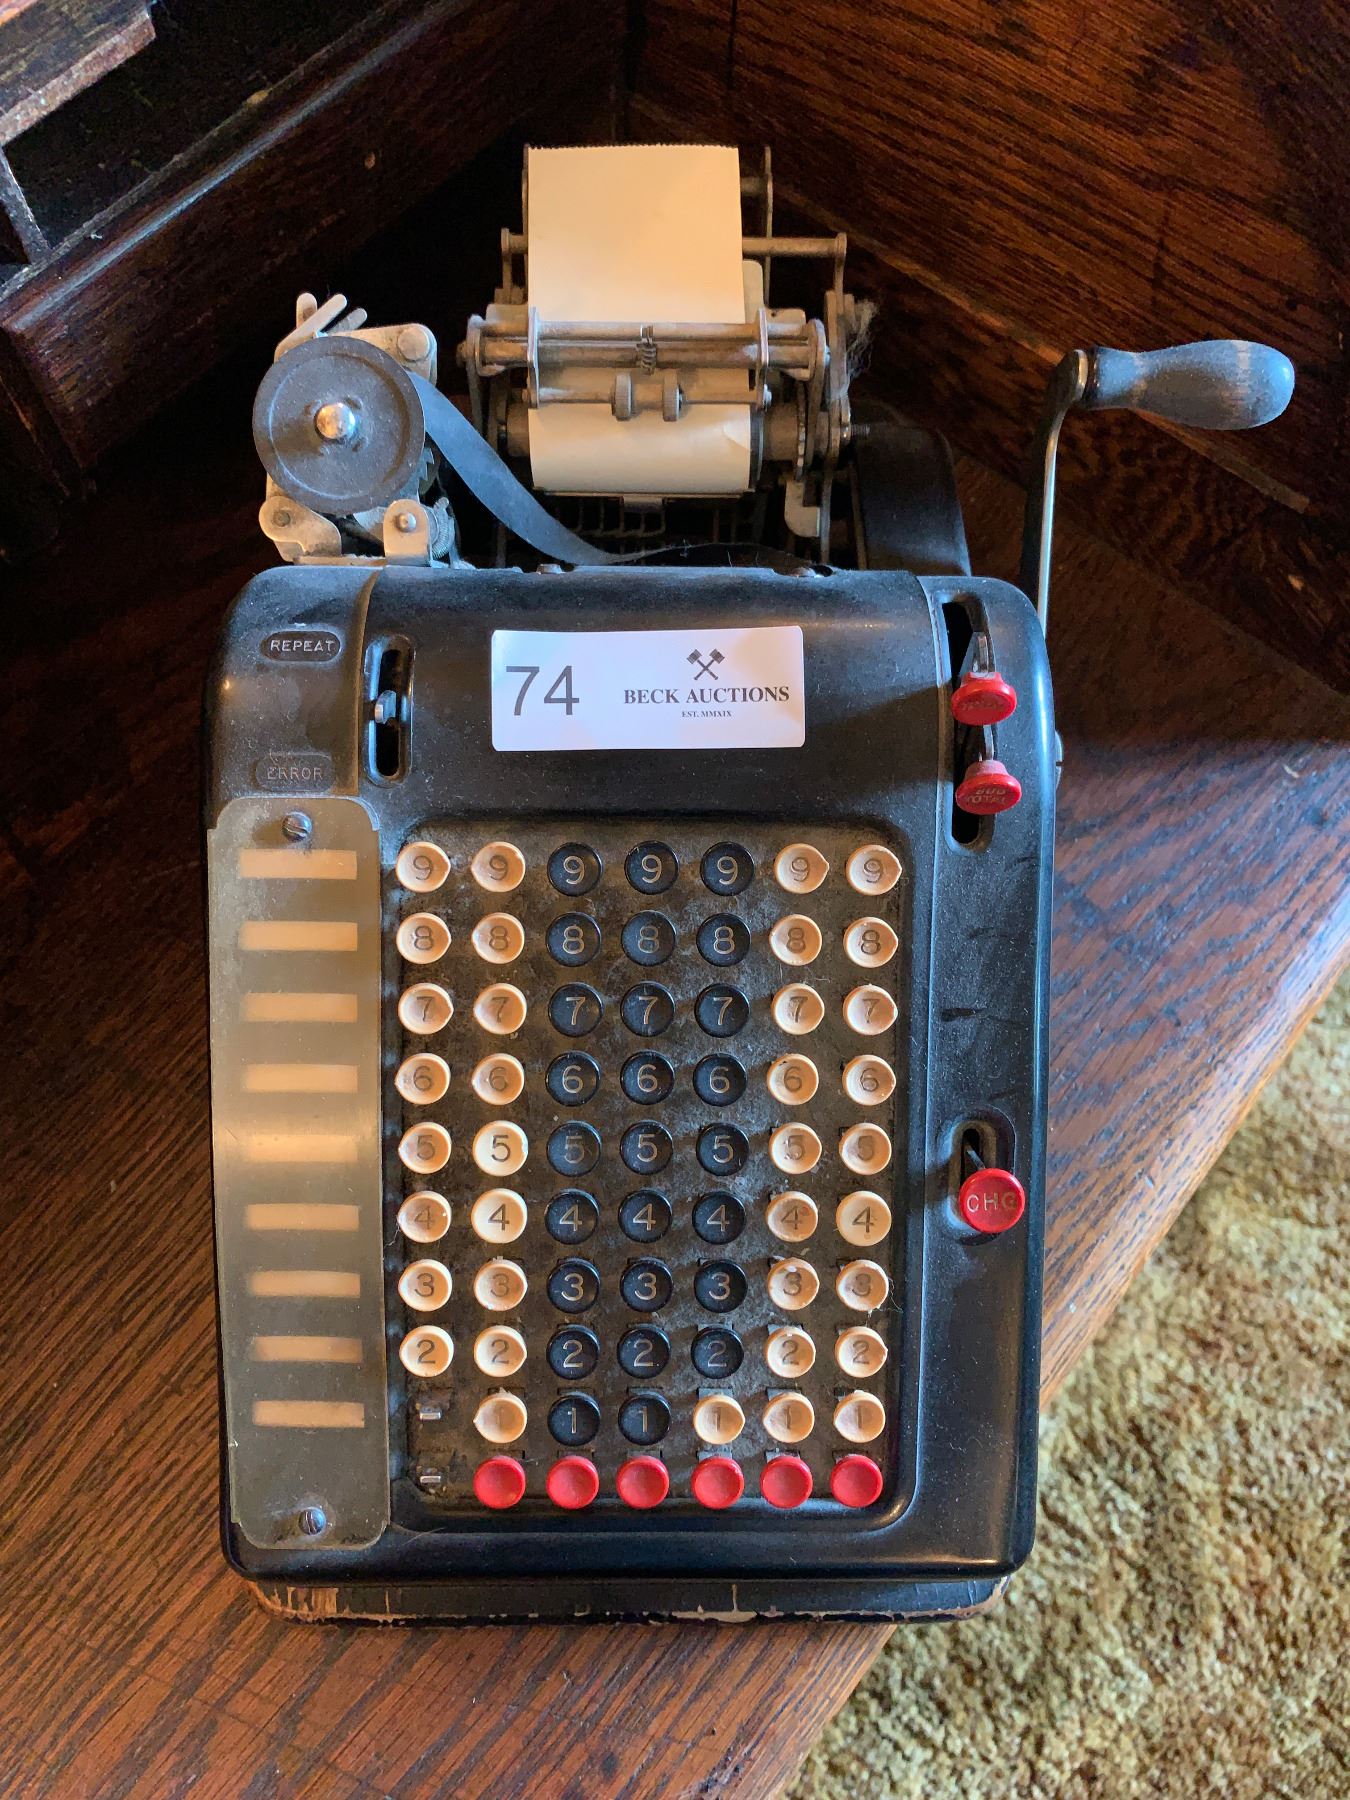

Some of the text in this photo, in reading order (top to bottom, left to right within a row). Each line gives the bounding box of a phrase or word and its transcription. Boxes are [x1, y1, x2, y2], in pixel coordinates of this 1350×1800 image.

[269, 639, 336, 653] REPEAT
[505, 664, 580, 716] 74
[623, 685, 791, 705] BECK AUCTIONS
[681, 710, 733, 719] EST. MMXIX
[267, 766, 324, 781] ERROR
[413, 855, 433, 881] 9
[489, 854, 509, 881] 9
[565, 855, 585, 885] 9
[642, 855, 663, 884] 9
[718, 855, 738, 885] 9
[791, 856, 810, 882] 9
[863, 858, 883, 884] 9
[413, 925, 434, 951] 8
[488, 925, 509, 951] 8
[563, 925, 585, 954] 8
[638, 924, 660, 953] 8
[714, 926, 736, 955] 8
[786, 927, 806, 954] 8
[860, 929, 882, 955] 8
[416, 995, 435, 1023] 7
[491, 996, 510, 1023] 7
[565, 996, 587, 1026] 7
[638, 995, 659, 1025] 7
[712, 996, 733, 1026] 7
[789, 995, 808, 1023] 7
[861, 998, 881, 1024] 7
[413, 1065, 433, 1092] 6
[488, 1066, 509, 1092] 6
[561, 1065, 585, 1095] 6
[636, 1063, 658, 1093] 6
[709, 1065, 731, 1095] 6
[783, 1066, 803, 1093] 6
[859, 1067, 880, 1093] 6
[416, 1134, 435, 1161] 5
[491, 1134, 511, 1163] 5
[564, 1135, 585, 1164] 5
[636, 1132, 658, 1162] 5
[712, 1133, 734, 1163] 5
[785, 1134, 805, 1161] 5
[857, 1135, 875, 1162] 5
[966, 1191, 1017, 1213] CHG
[414, 1205, 435, 1230] 4
[487, 1203, 511, 1231] 4
[558, 1202, 583, 1232] 4
[632, 1202, 657, 1232] 4
[706, 1203, 731, 1233] 4
[781, 1205, 803, 1231] 4
[851, 1206, 875, 1234] 4
[414, 1272, 435, 1298] 3
[490, 1272, 511, 1298] 3
[560, 1272, 585, 1302] 3
[634, 1271, 658, 1301] 3
[708, 1271, 731, 1301] 3
[782, 1271, 802, 1297] 3
[851, 1273, 872, 1297] 3
[416, 1339, 436, 1365] 2
[490, 1338, 510, 1364] 2
[562, 1338, 585, 1368] 2
[633, 1338, 655, 1368] 2
[707, 1338, 728, 1368] 2
[782, 1339, 800, 1366] 2
[852, 1340, 871, 1365] 2
